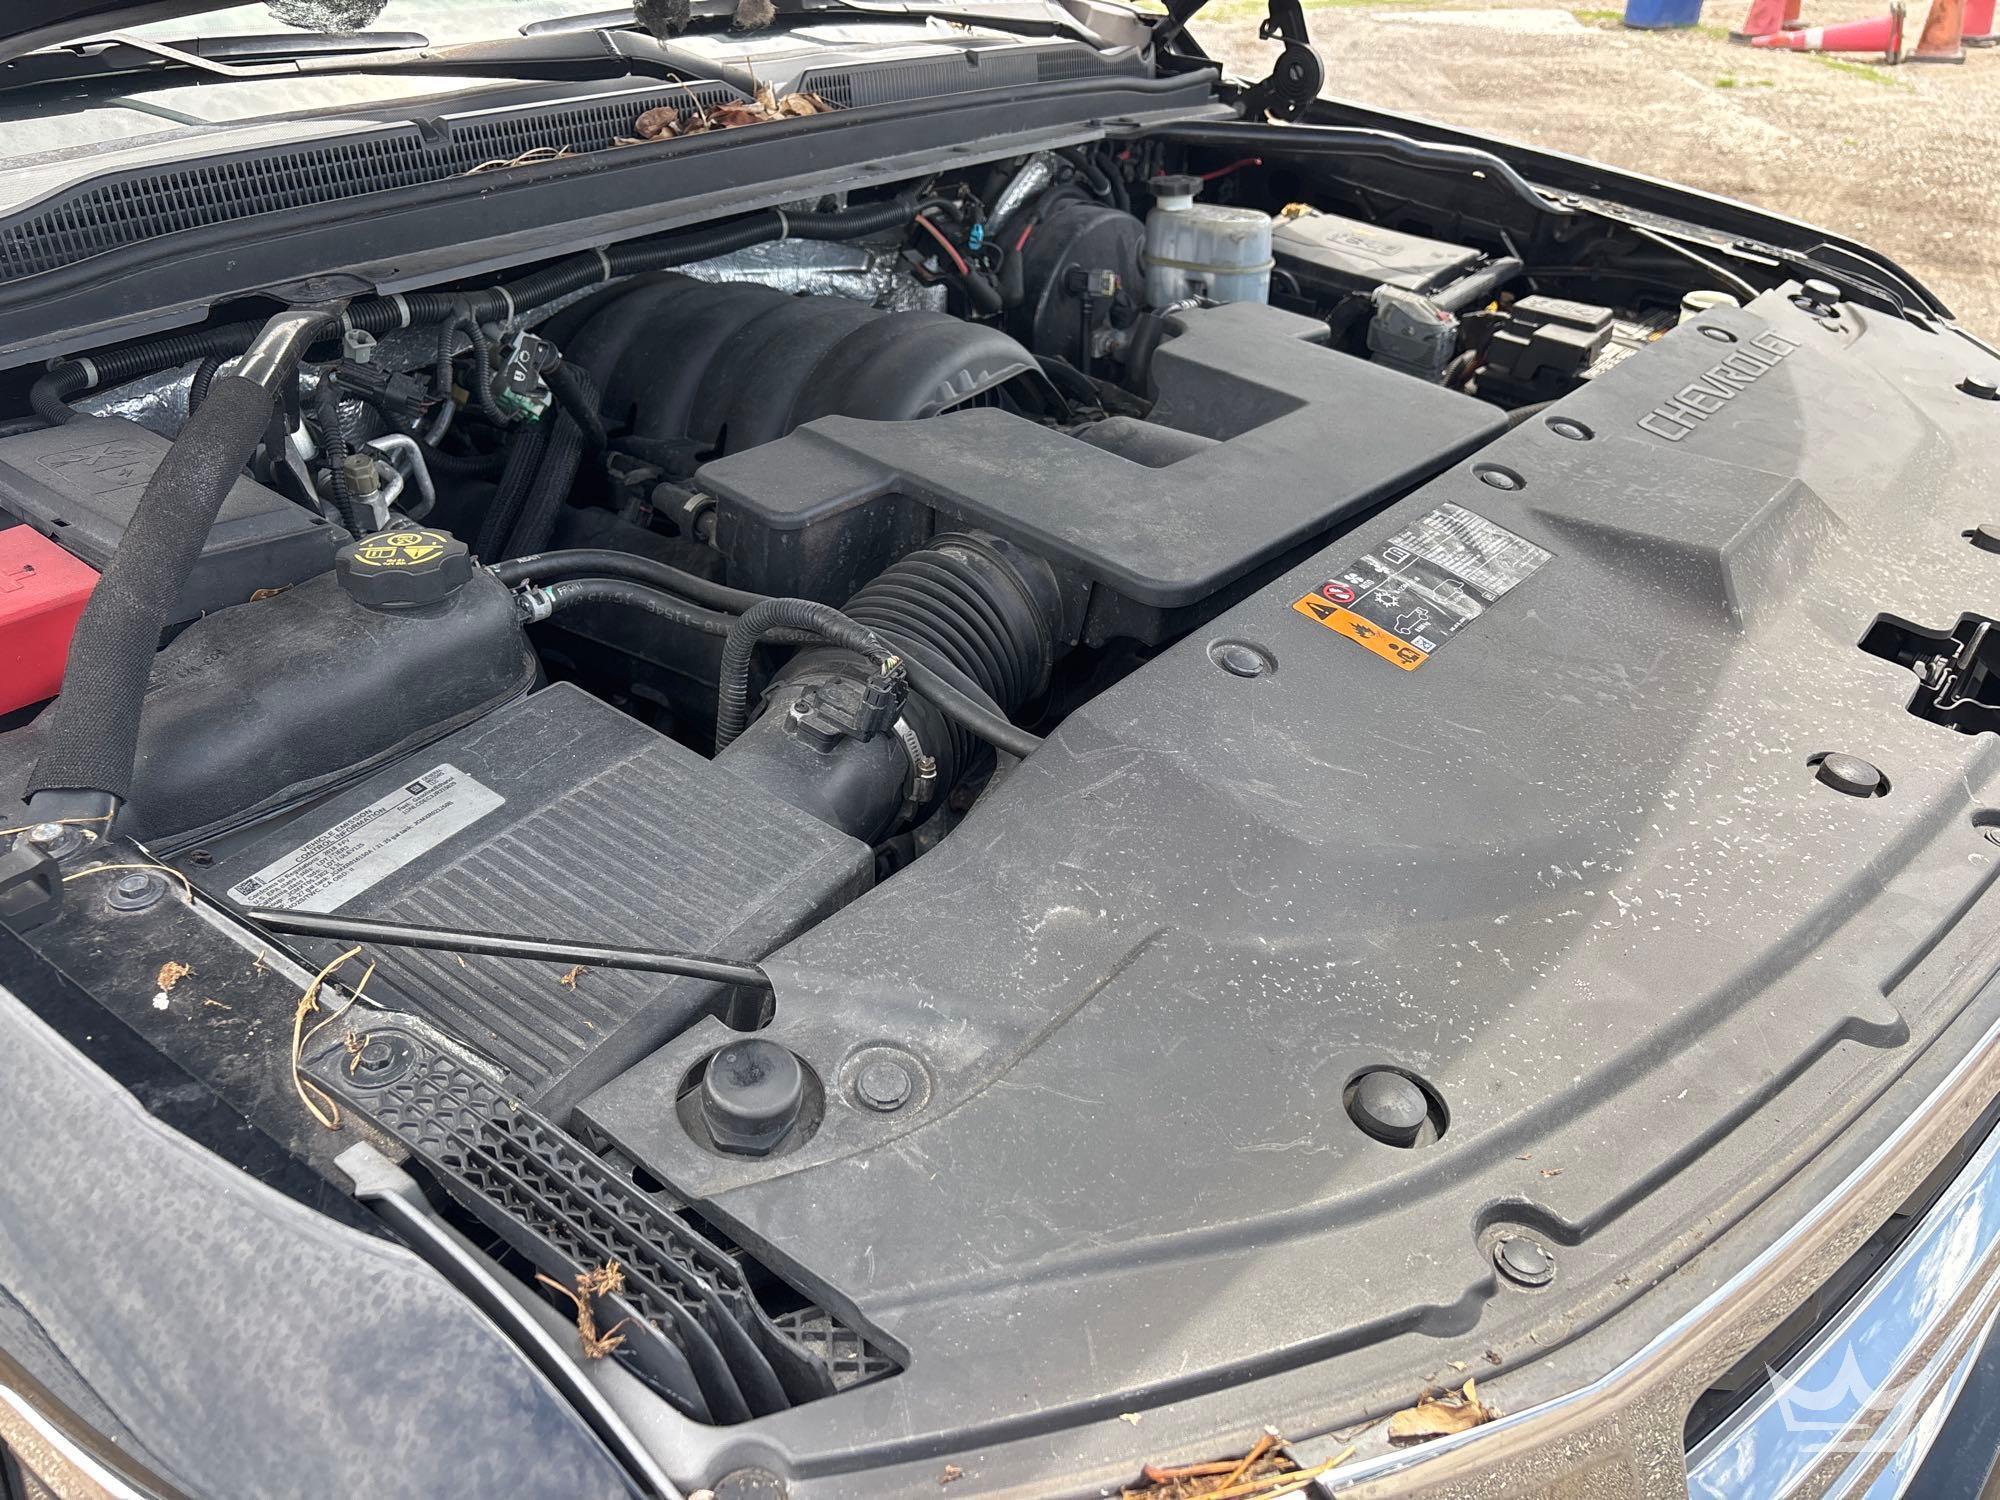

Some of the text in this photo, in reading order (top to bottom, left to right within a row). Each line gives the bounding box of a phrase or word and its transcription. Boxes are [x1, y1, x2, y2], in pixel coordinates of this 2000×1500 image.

[1637, 329, 1801, 442] CHEVROLET
[557, 582, 583, 596] FRONT
[295, 807, 387, 863] CONTROL INFORMATION
[300, 809, 373, 852] VEHICLE EMISSION
[247, 882, 278, 901] Conforms
[266, 887, 280, 896] EPA
[279, 877, 297, 888] class
[287, 880, 304, 890] class
